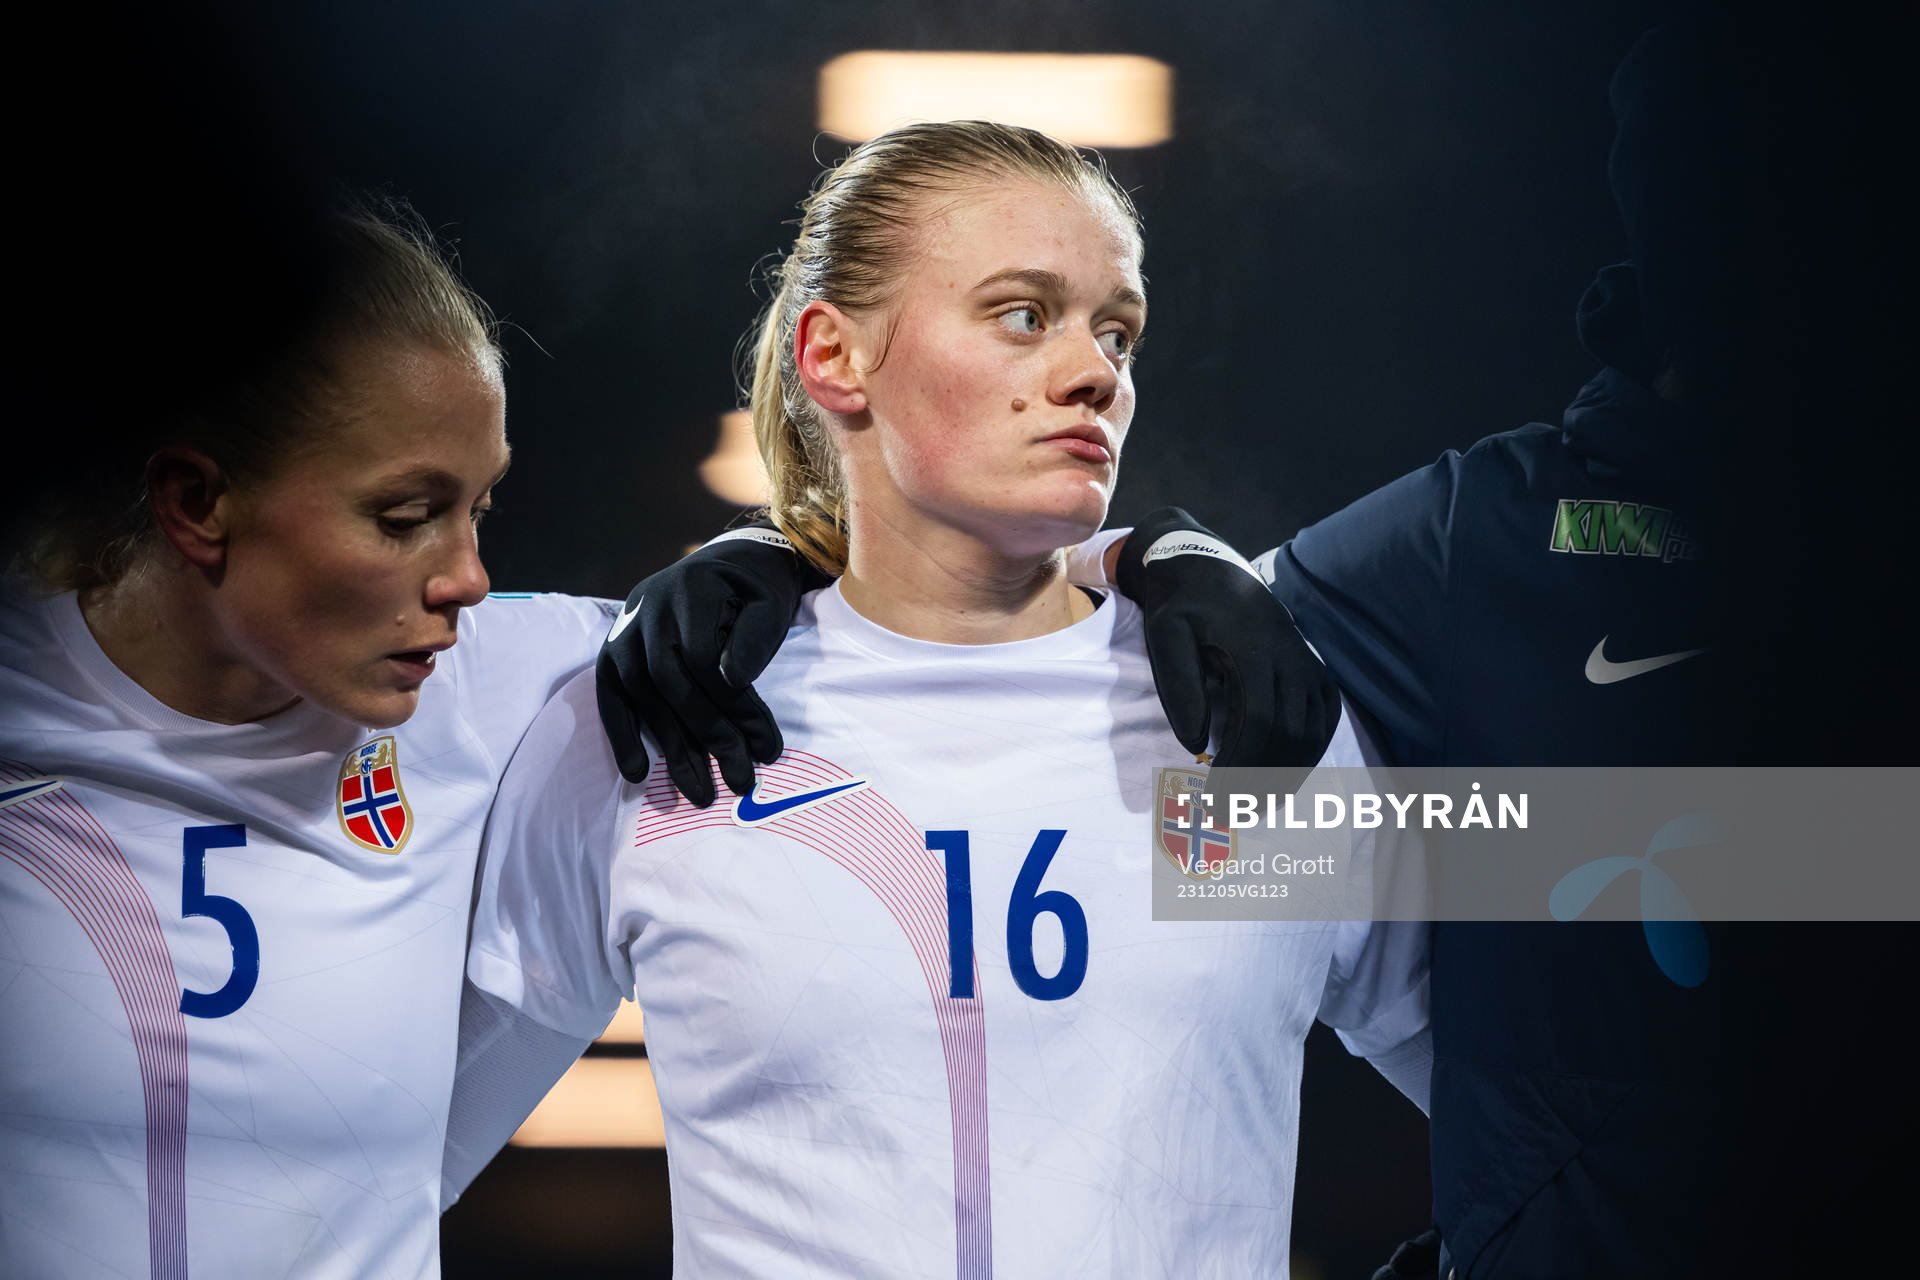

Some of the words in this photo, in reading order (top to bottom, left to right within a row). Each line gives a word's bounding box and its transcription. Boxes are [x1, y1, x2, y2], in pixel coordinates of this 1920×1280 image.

[1550, 499, 1672, 558] KIWI
[1187, 776, 1207, 789] NOR
[179, 823, 260, 1019] 5
[925, 829, 1089, 1001] 16
